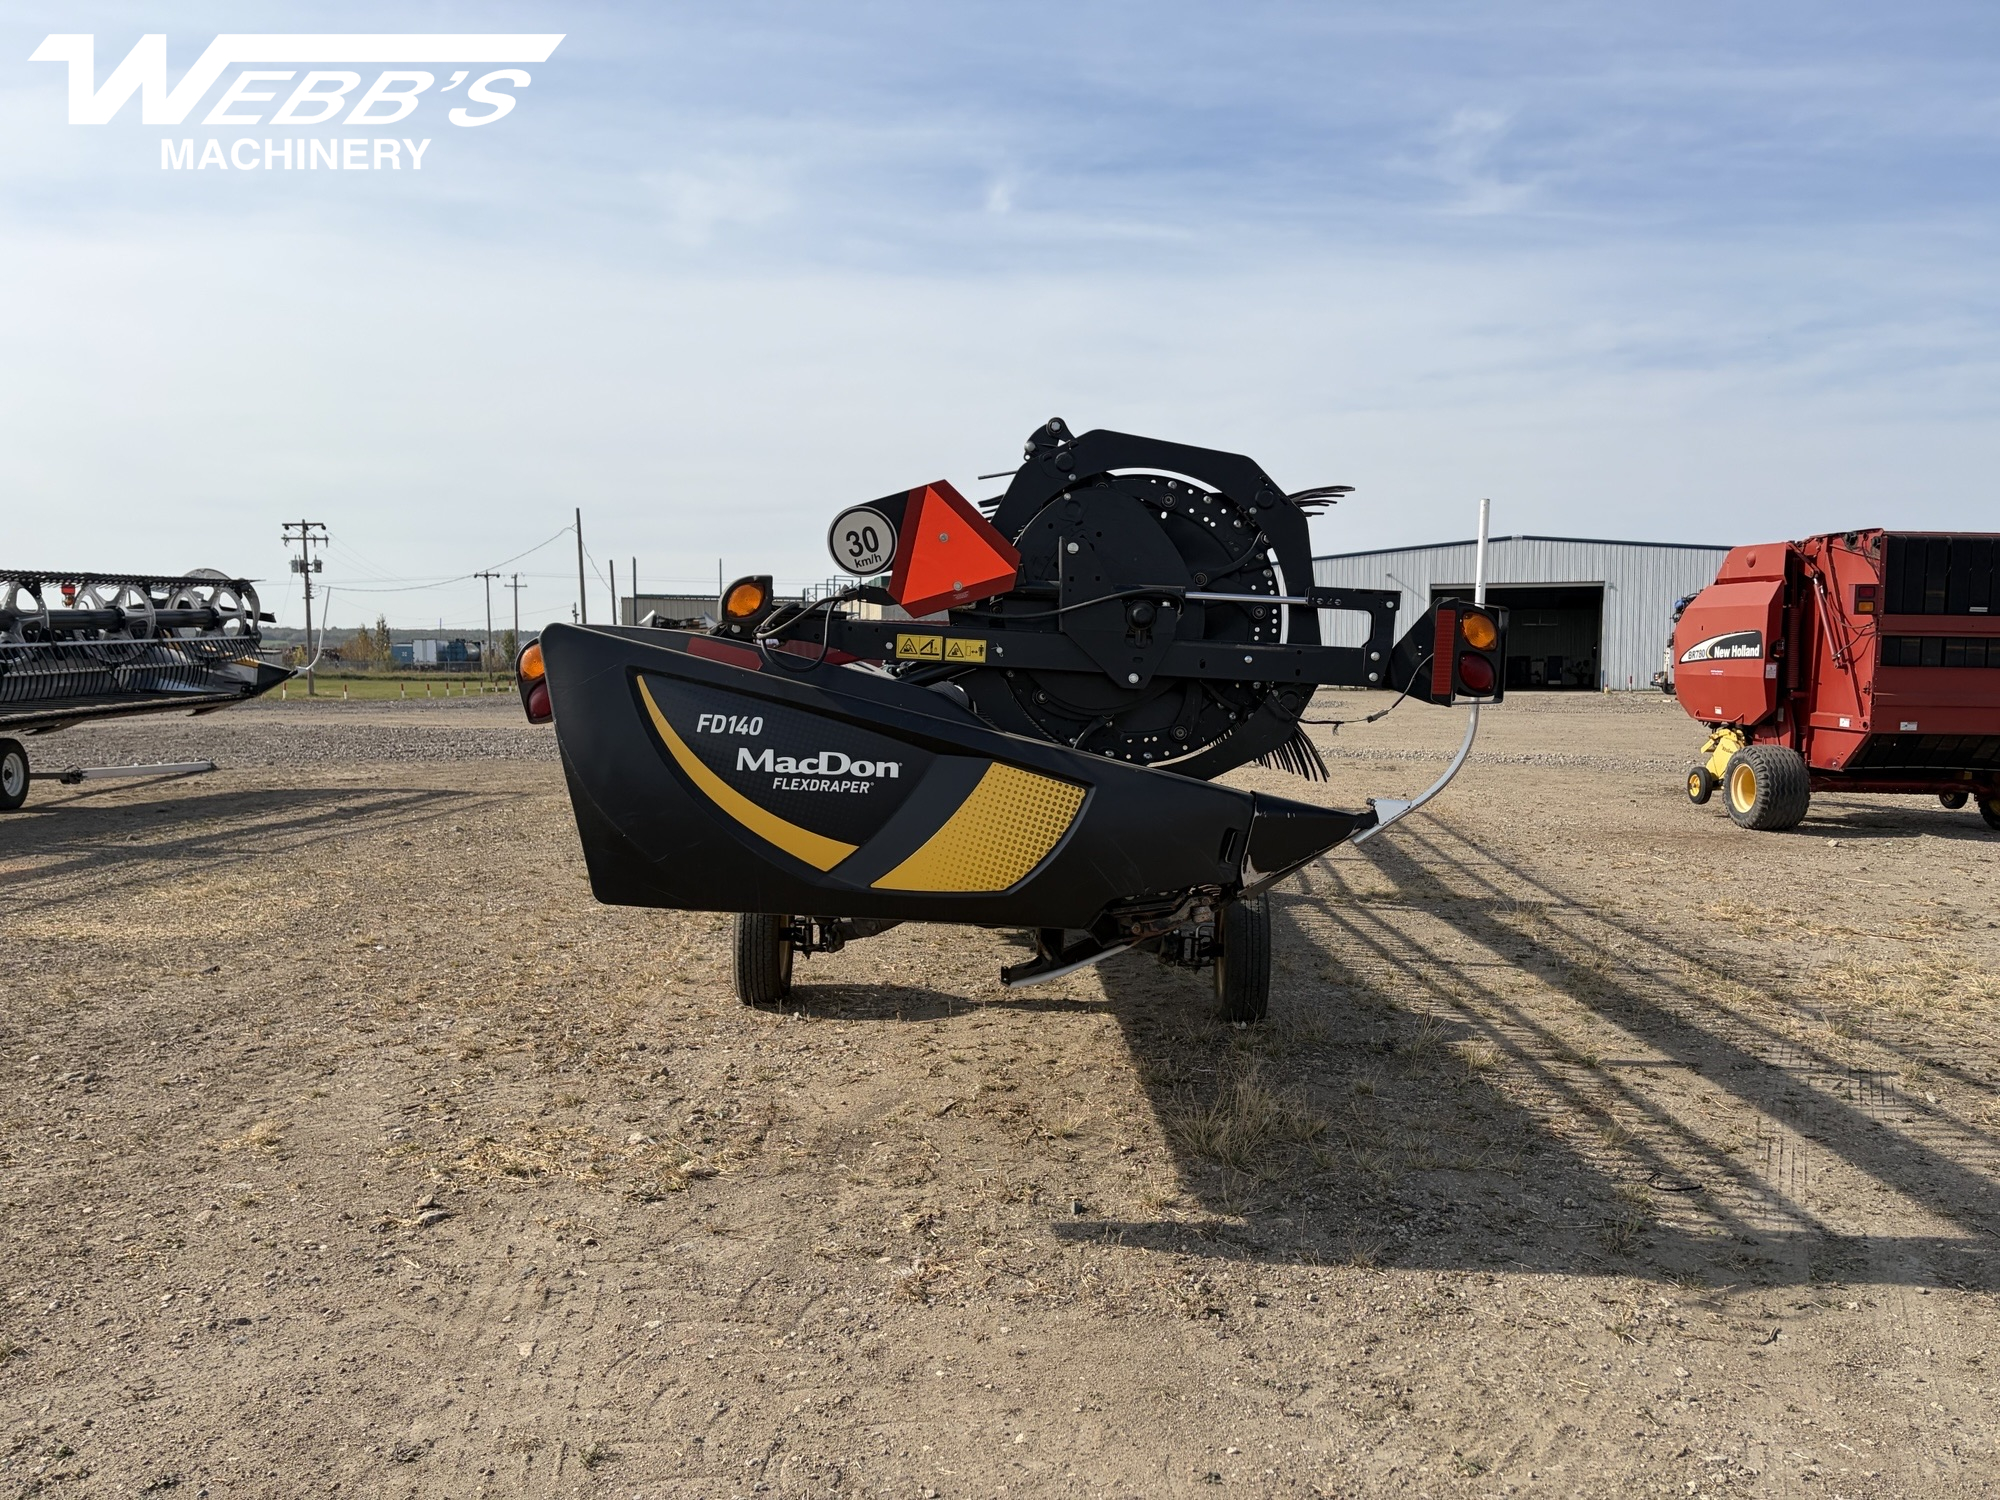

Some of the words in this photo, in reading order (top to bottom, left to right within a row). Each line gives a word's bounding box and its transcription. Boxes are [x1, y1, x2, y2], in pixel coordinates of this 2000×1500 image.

[845, 526, 880, 558] 30
[854, 553, 882, 568] km/h
[1713, 645, 1730, 658] New
[1731, 643, 1760, 658] Holland
[696, 713, 764, 736] FD140
[736, 747, 900, 779] MacDon
[772, 777, 871, 794] FLEXDRAPER
